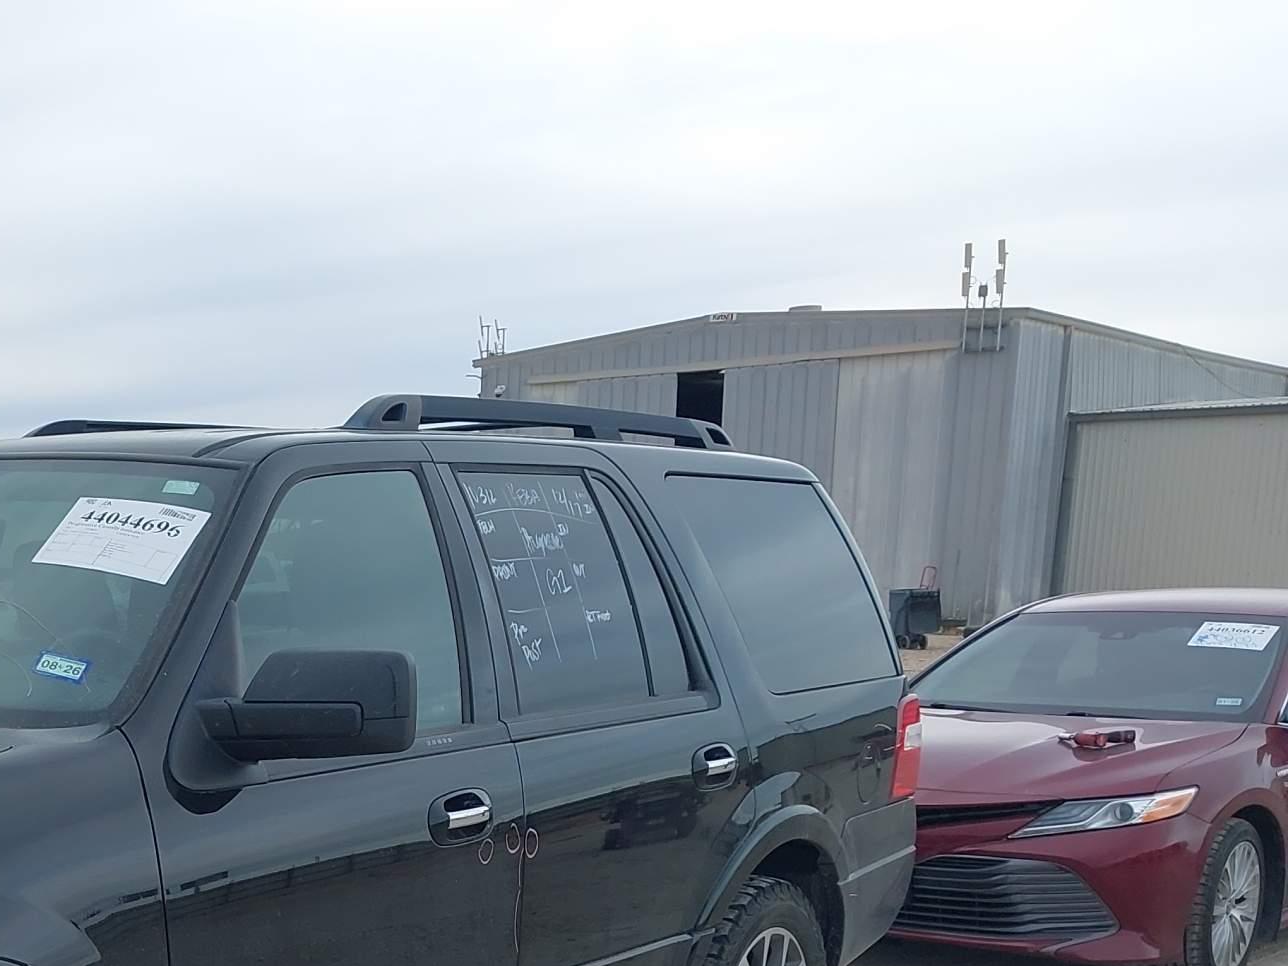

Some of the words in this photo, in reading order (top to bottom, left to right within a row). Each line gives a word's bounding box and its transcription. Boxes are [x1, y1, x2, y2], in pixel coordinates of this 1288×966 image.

[80, 510, 184, 538] 44044696
[40, 659, 59, 671] 08
[63, 664, 83, 676] 26
